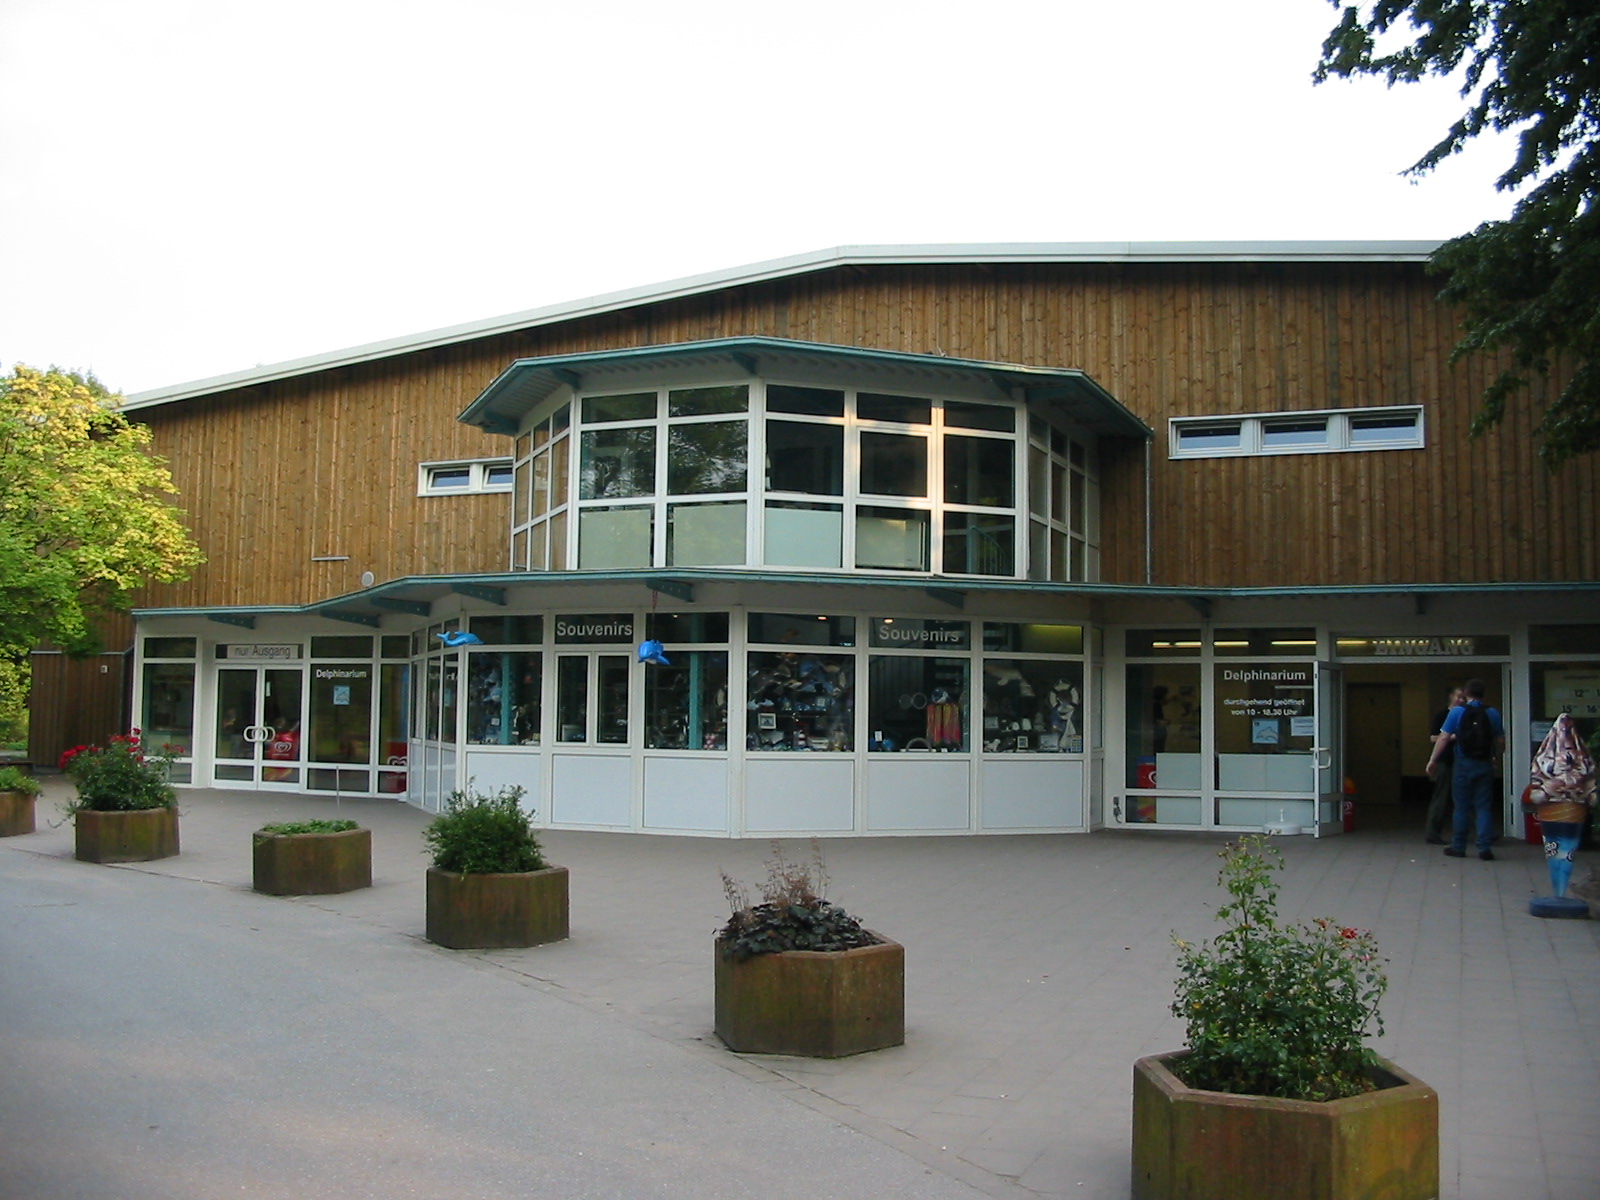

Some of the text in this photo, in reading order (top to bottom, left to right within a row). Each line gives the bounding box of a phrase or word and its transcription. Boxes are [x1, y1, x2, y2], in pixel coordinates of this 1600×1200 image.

[556, 621, 633, 636] Souvenirs
[879, 625, 960, 642] Souvenirs
[234, 645, 291, 659] nur Ausgang
[1375, 638, 1474, 655] EINGANG
[316, 669, 367, 680] Delphinarium
[1224, 669, 1306, 682] Delphinarium
[1223, 698, 1305, 707] durchgehend geöffnet
